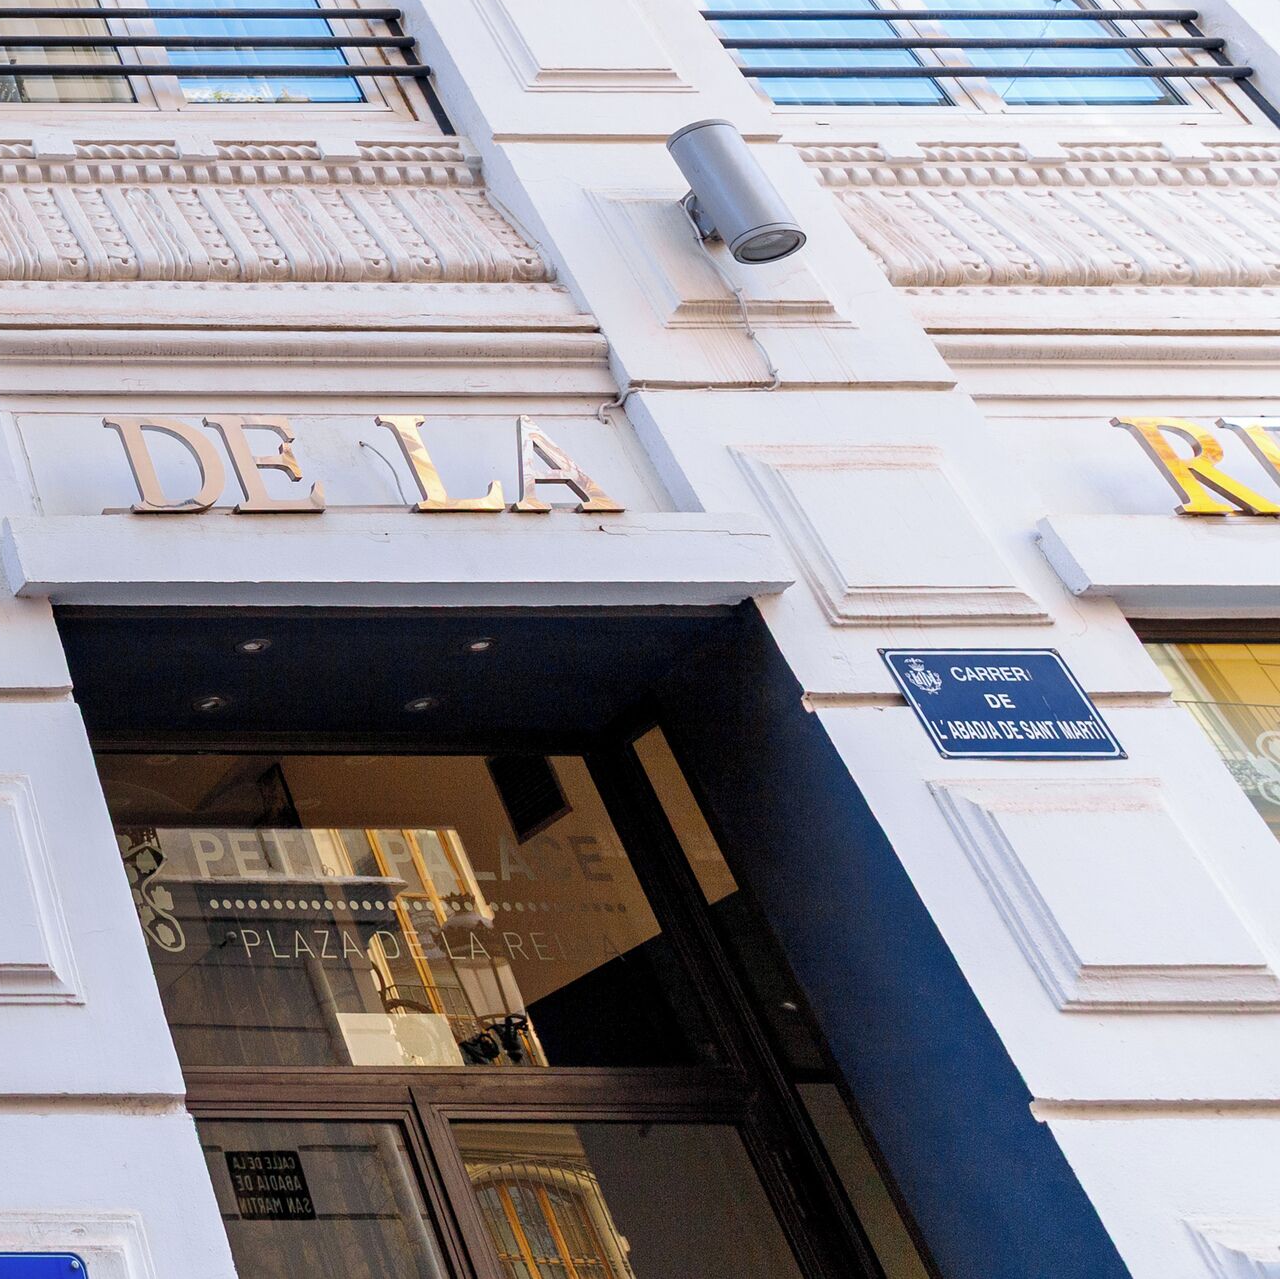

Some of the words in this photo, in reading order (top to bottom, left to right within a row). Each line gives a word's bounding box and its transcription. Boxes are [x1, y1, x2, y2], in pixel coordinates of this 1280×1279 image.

[101, 416, 326, 514] DE
[375, 415, 626, 513] LA
[950, 666, 1030, 682] CARRER
[984, 693, 1016, 708] DE
[998, 720, 1024, 740] DE
[1019, 720, 1060, 740] SANT
[1056, 715, 1106, 740] MARTÍ
[240, 929, 368, 961] PLAZA
[376, 930, 428, 960] DE
[441, 931, 493, 961] LA
